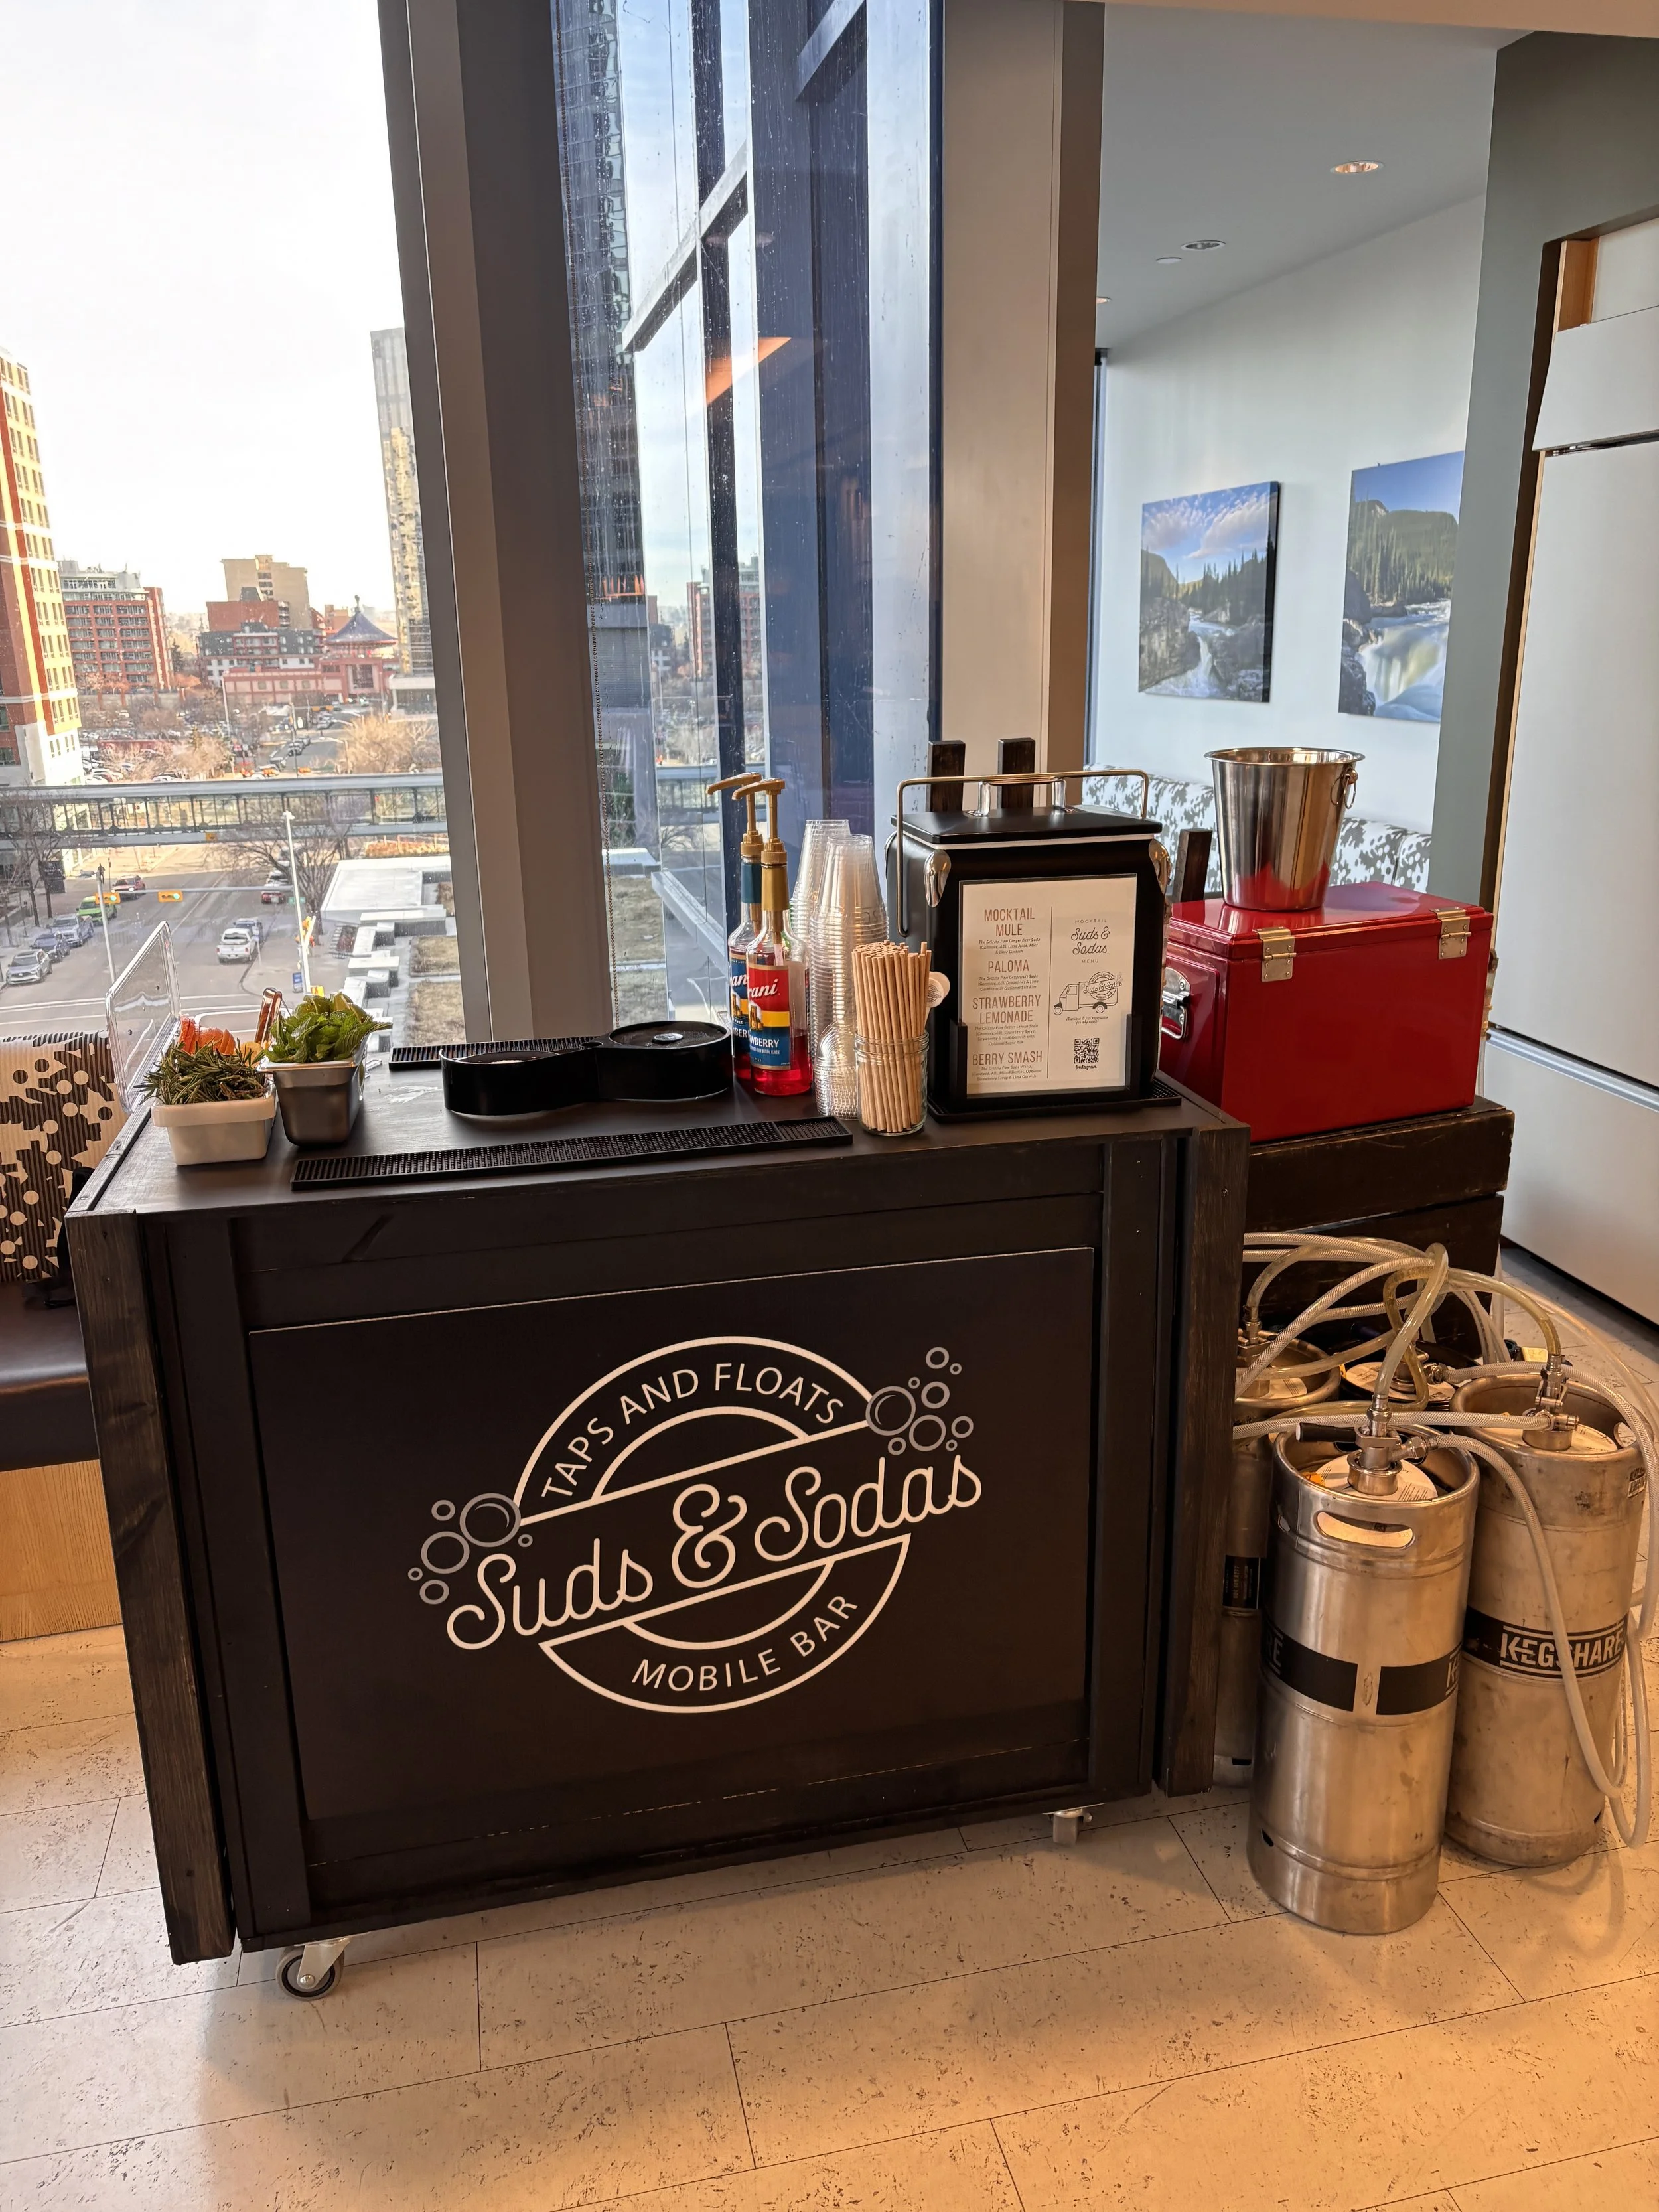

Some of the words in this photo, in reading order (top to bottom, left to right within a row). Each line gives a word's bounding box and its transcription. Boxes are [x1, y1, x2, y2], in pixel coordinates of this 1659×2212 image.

[984, 907, 1035, 921] MOCKTAIL
[996, 924, 1023, 936] MULE
[1071, 927, 1098, 941] Suds
[1100, 926, 1110, 940] &
[1072, 941, 1107, 955] Sodas
[988, 960, 1029, 973] PALOMA
[749, 978, 778, 998] rani
[973, 994, 1041, 1009] STRAWBERRY
[979, 1010, 1033, 1024] LEMONADE
[750, 1035, 779, 1048] WBERRY
[973, 1052, 1004, 1065] BERRY
[1008, 1051, 1042, 1063] SMASH
[540, 1417, 614, 1499] TAPS
[619, 1368, 699, 1425] AND
[714, 1363, 845, 1424] FLOATS
[446, 1538, 654, 1650] Suds
[671, 1483, 747, 1589] &
[754, 1454, 982, 1562] Sodas
[631, 1650, 782, 1692] MOBILE
[789, 1594, 858, 1657] BAR
[1500, 1628, 1623, 1668] KEGHARE
